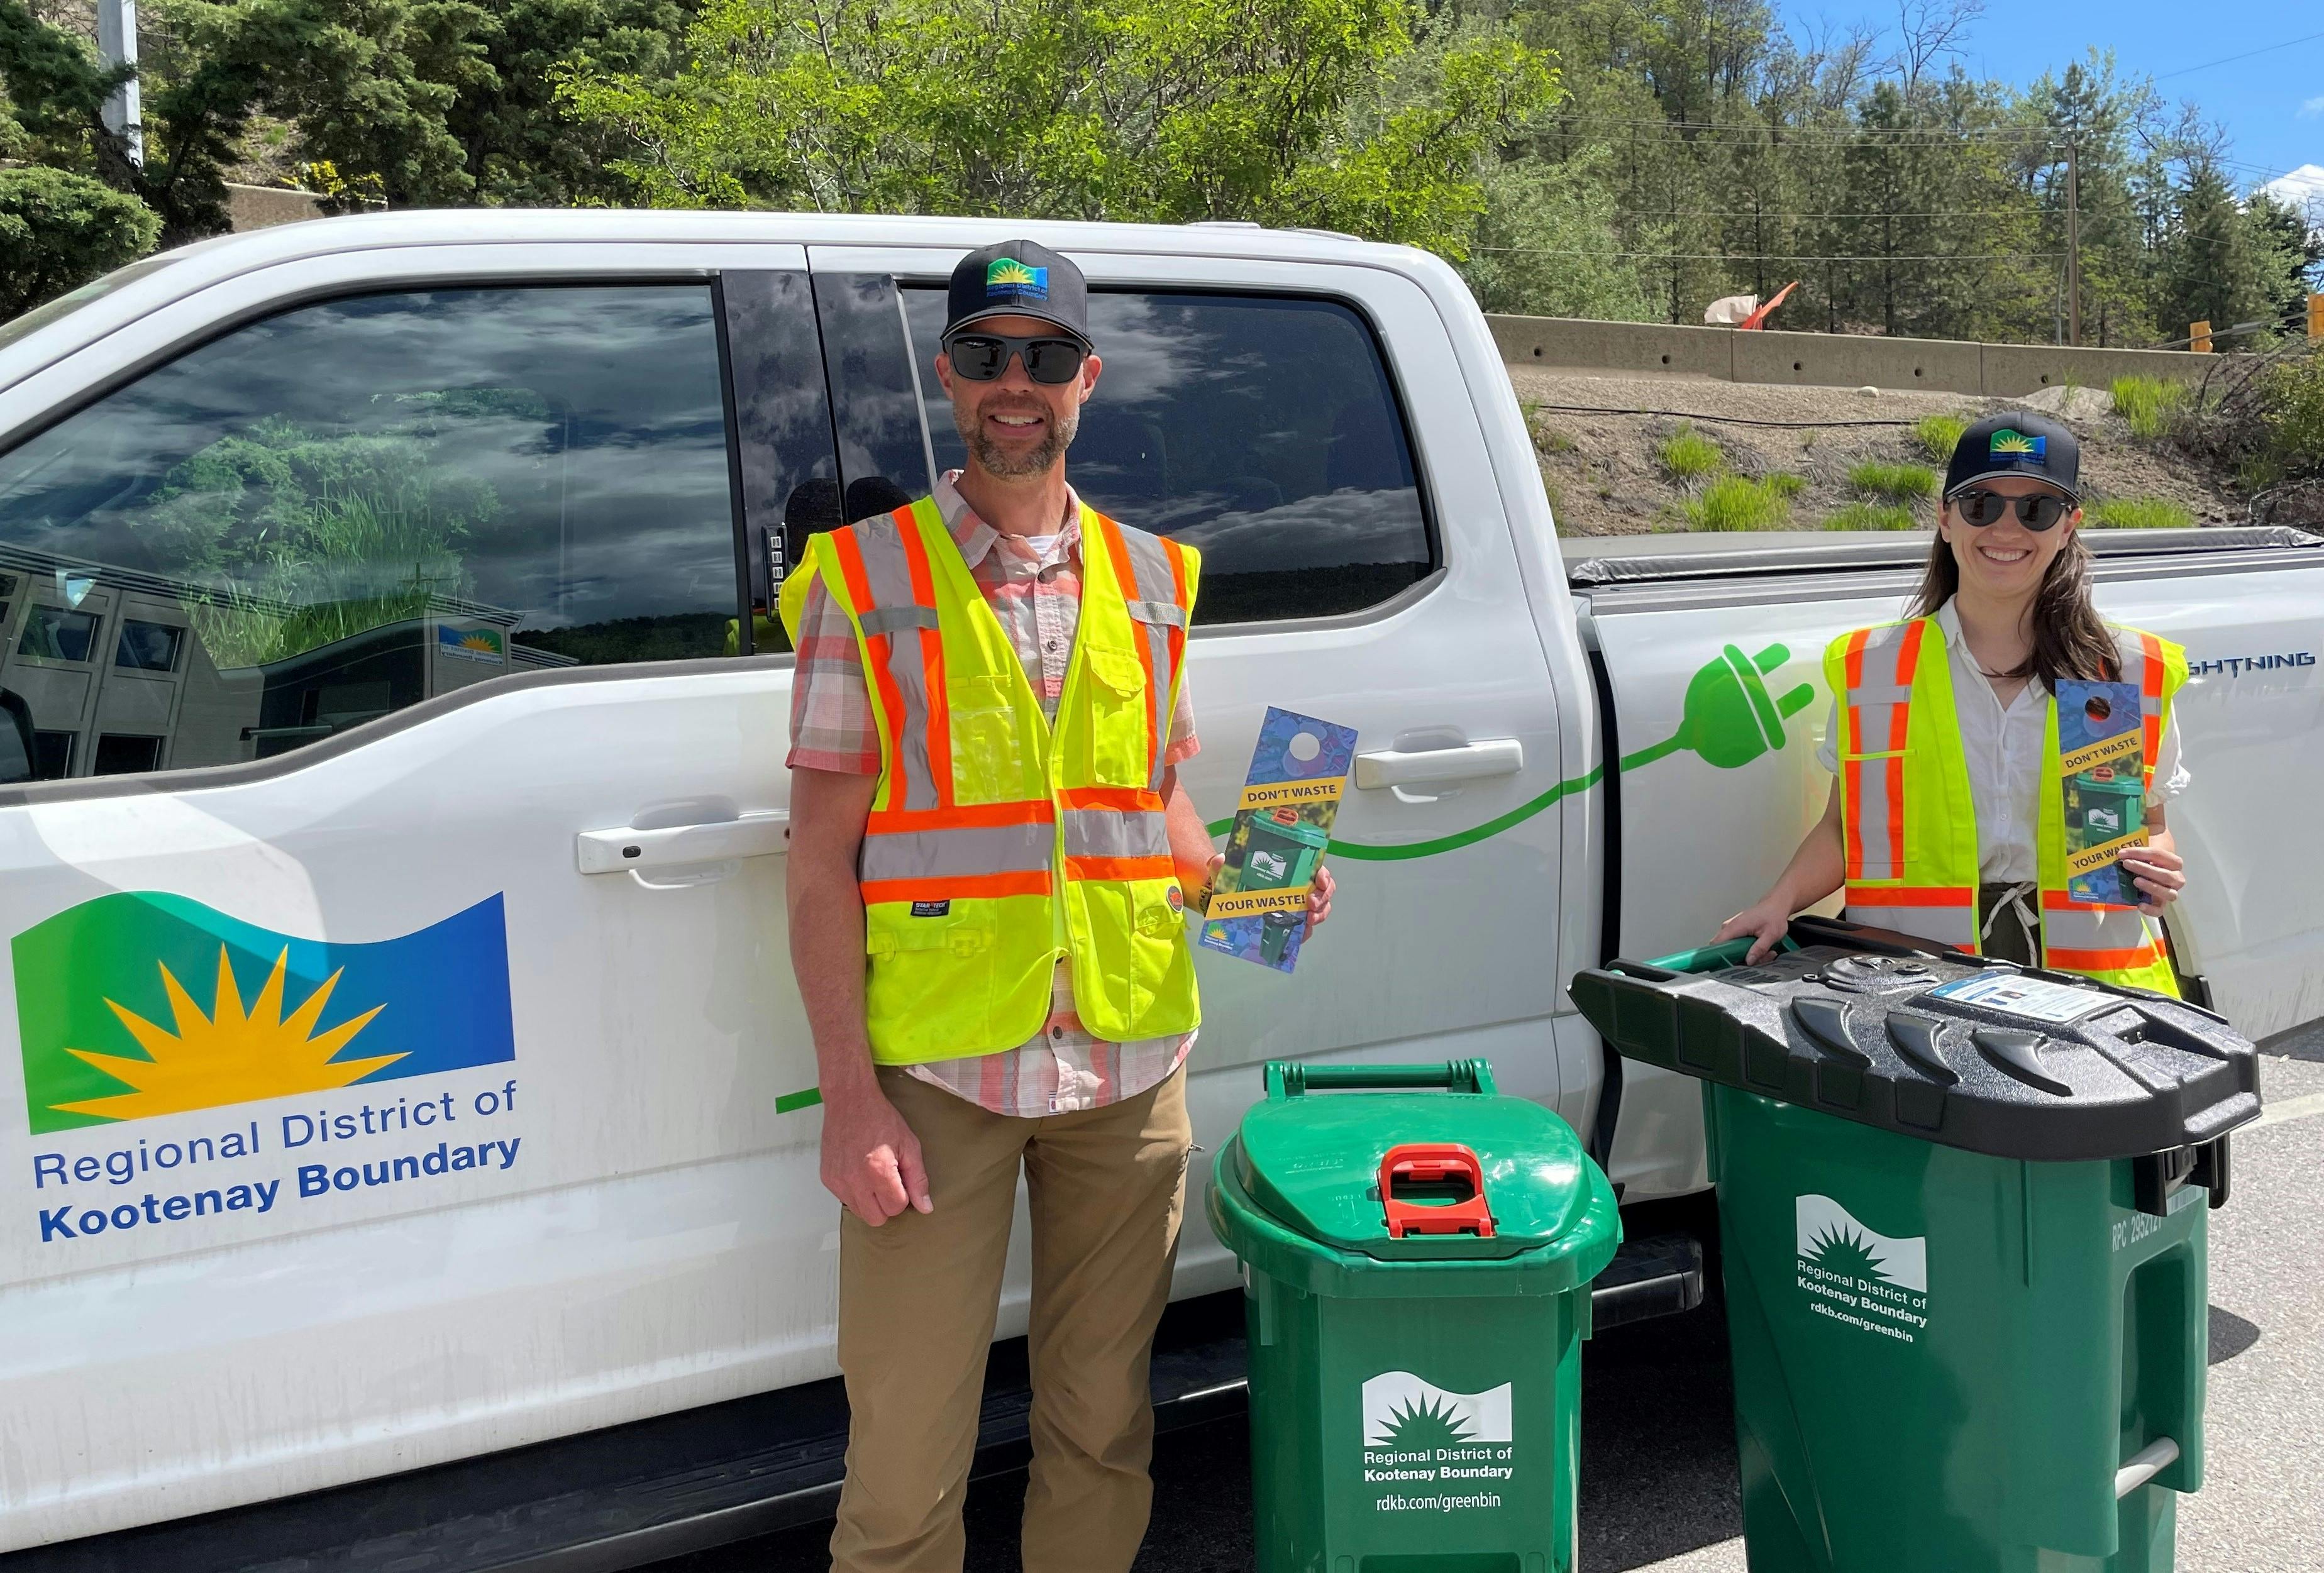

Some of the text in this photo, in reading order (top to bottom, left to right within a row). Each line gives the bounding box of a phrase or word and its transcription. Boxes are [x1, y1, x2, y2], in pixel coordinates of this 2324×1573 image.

[2101, 737, 2138, 756] WASTE
[1291, 783, 1337, 798] WASTE
[2072, 853, 2104, 869] YOUR
[1216, 893, 1306, 912] YOUR WASTE!
[33, 1080, 516, 1189] Regional District of
[38, 1137, 521, 1244] Kootenay Boundary
[2112, 1220, 2127, 1252] RPC
[1797, 1259, 1927, 1310] Regional District of
[1797, 1276, 1927, 1328] Kootenay Boundary
[1810, 1302, 1913, 1343] rdkb.com/greenbin
[1364, 1447, 1512, 1465] Regional District of
[1364, 1465, 1513, 1481] Kootenay Boundary
[1376, 1492, 1501, 1513] rdkb.com/greenbin
